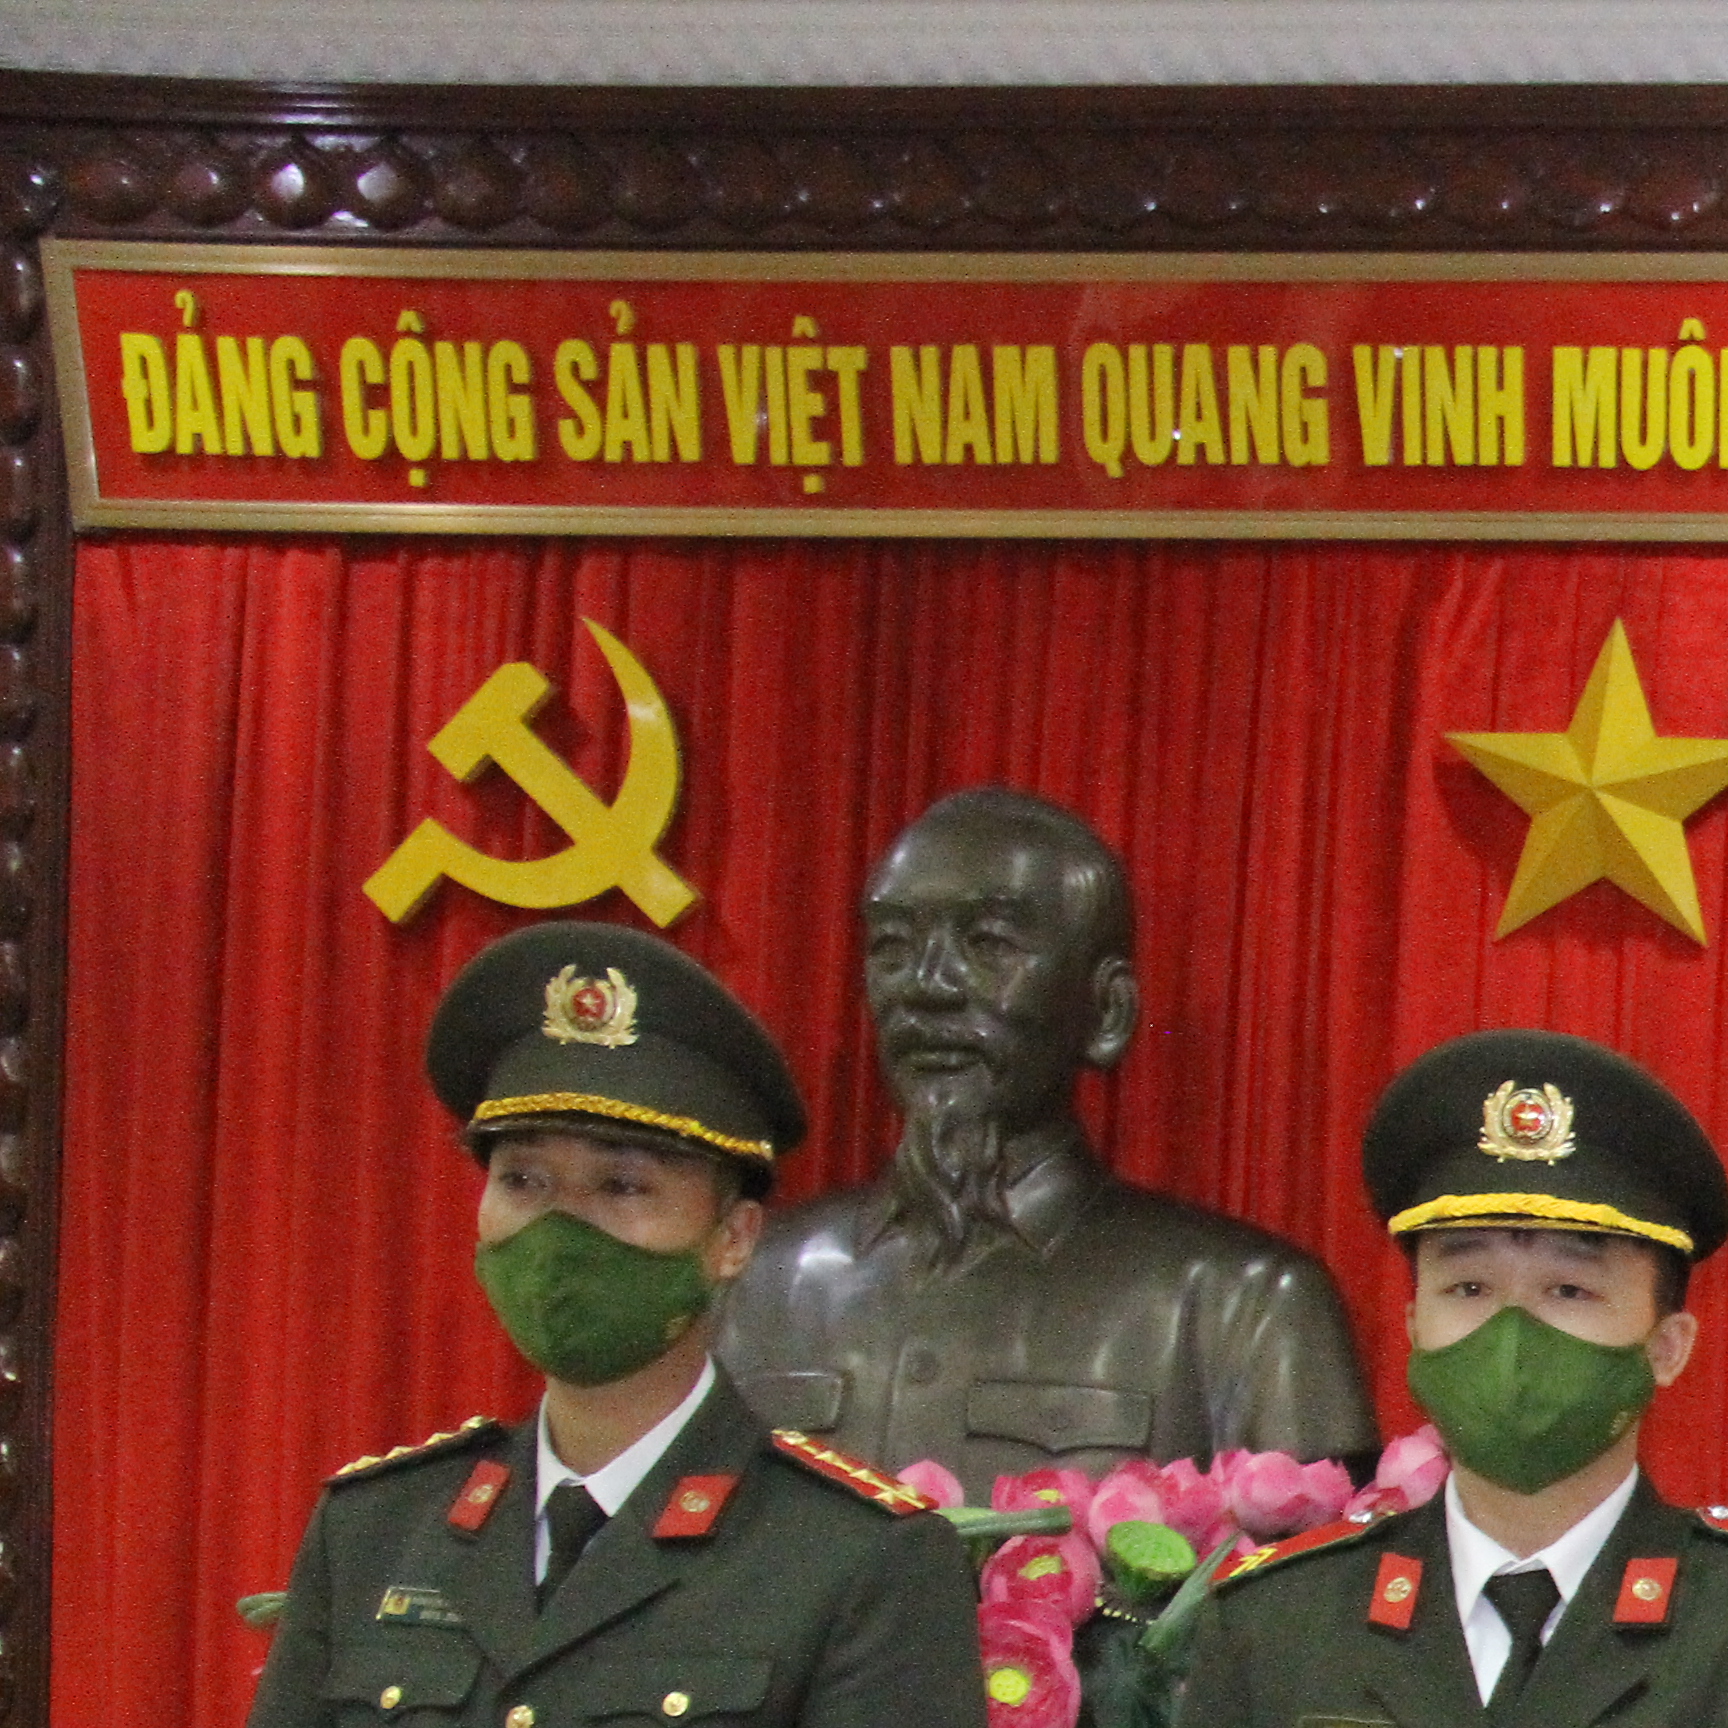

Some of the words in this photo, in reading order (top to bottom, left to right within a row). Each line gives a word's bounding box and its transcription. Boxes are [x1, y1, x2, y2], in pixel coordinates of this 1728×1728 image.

[119, 289, 321, 459] ĐẢNG
[340, 309, 535, 487] CỘNG
[554, 300, 701, 462] SẢN
[718, 316, 867, 493] VIỆT
[891, 345, 1058, 465] NAM
[1082, 342, 1330, 477] QUANG
[1353, 344, 1526, 467] VINH
